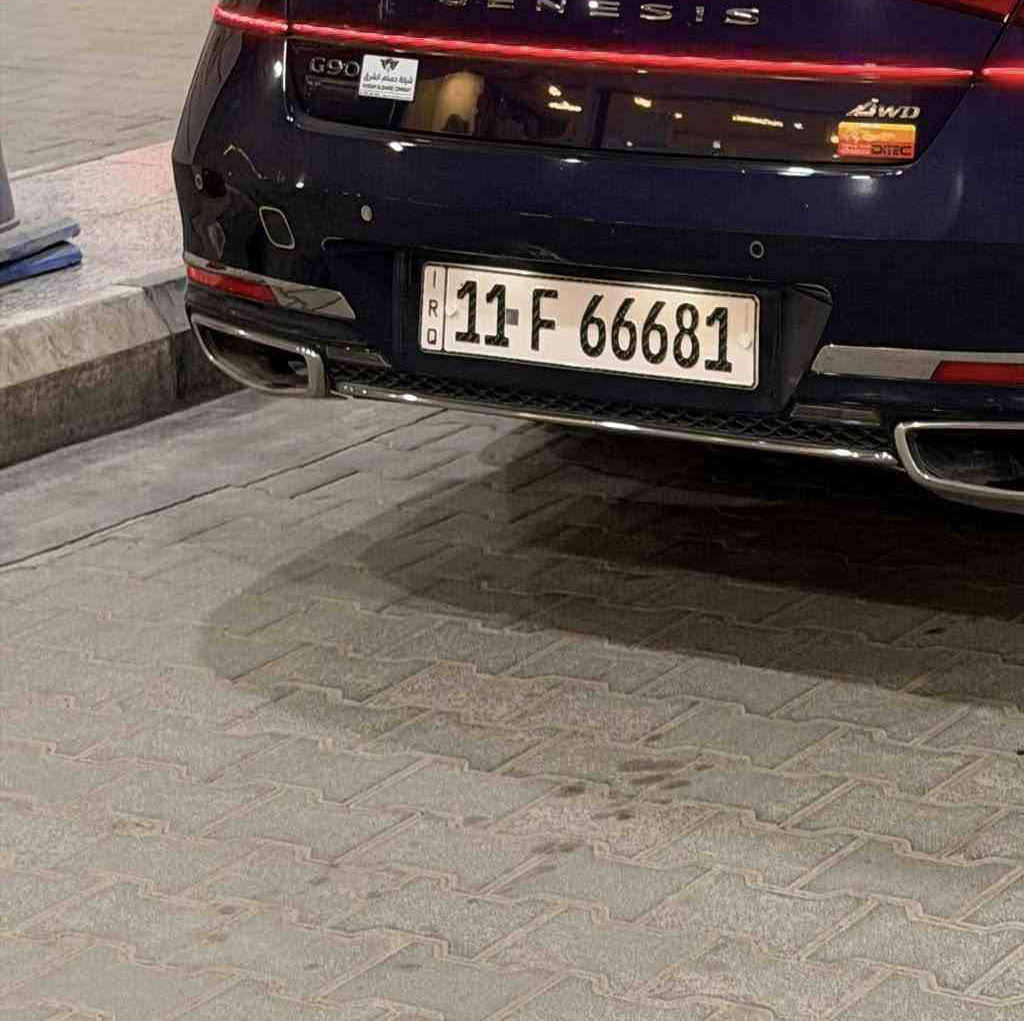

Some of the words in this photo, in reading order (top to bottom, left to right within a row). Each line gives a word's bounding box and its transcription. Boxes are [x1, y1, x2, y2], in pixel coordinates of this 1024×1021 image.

[311, 58, 360, 77] G90
[425, 269, 440, 347] IRQ
[455, 279, 510, 349] 11
[530, 288, 559, 352] F
[579, 294, 733, 373] 66681
